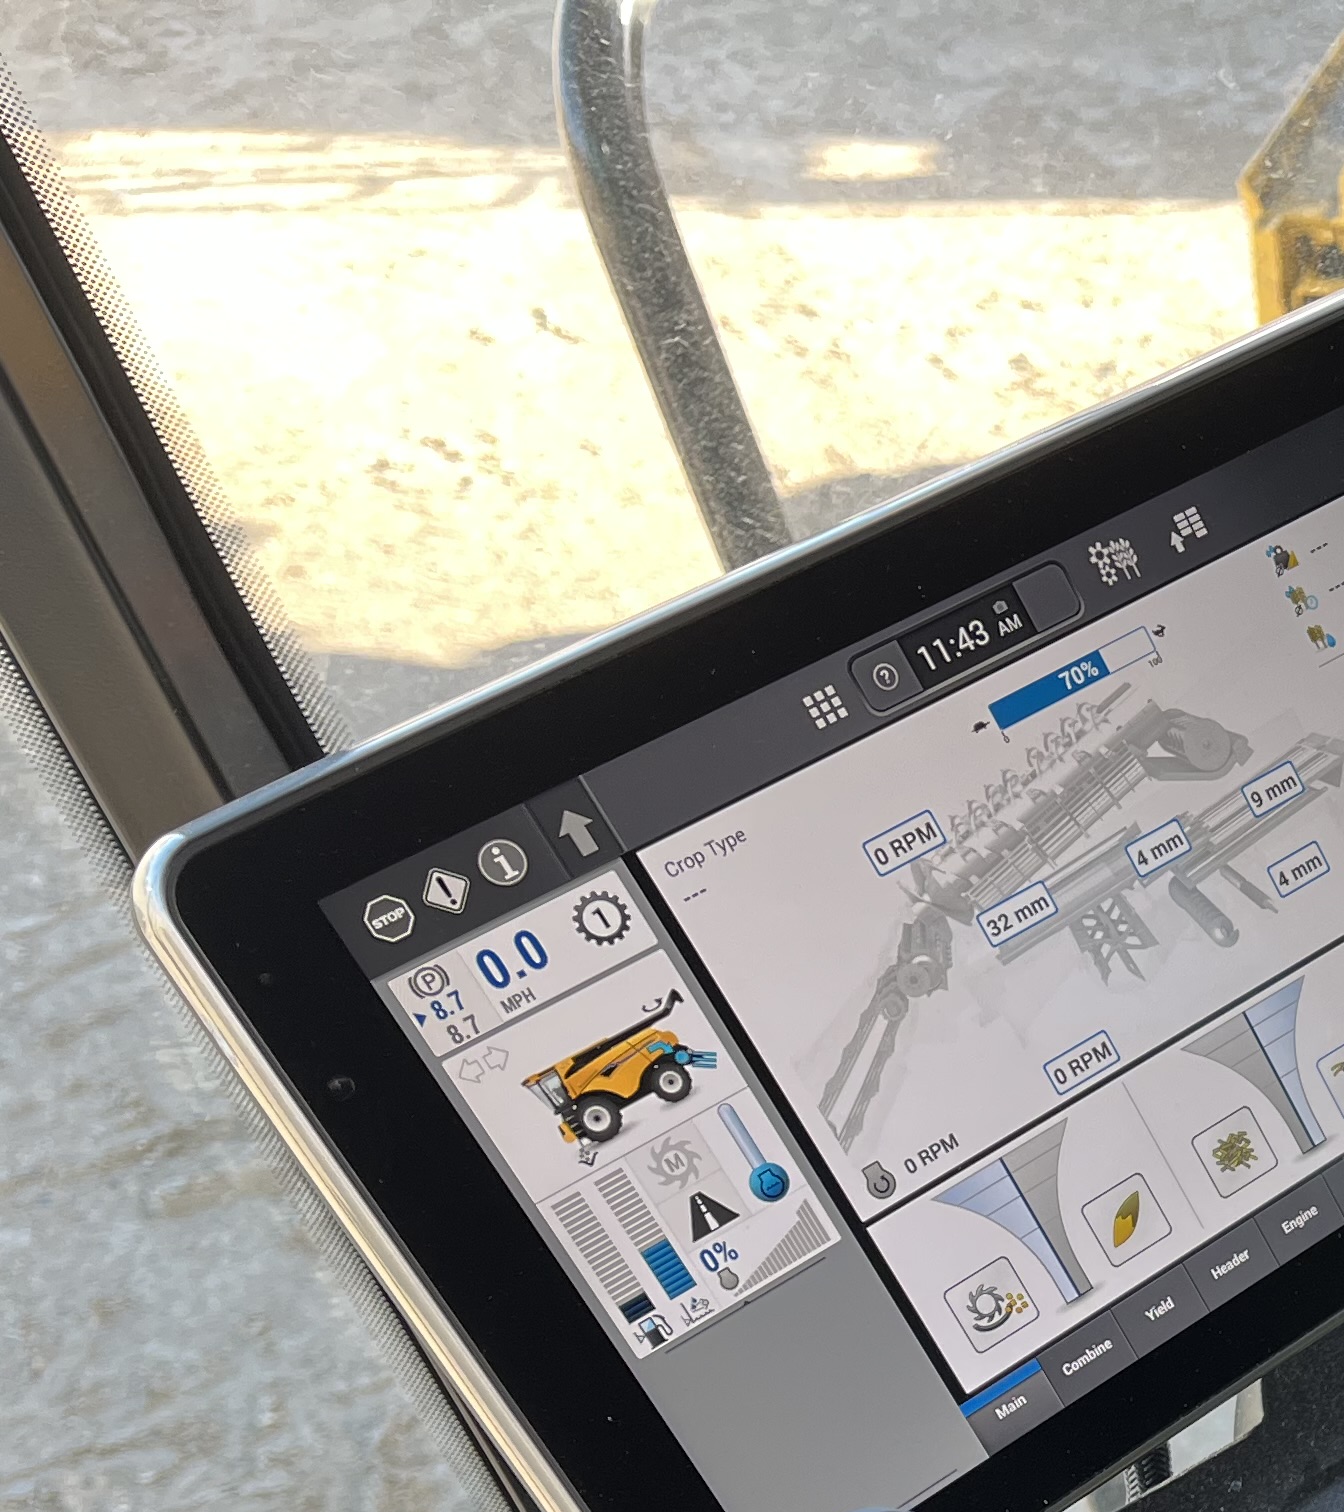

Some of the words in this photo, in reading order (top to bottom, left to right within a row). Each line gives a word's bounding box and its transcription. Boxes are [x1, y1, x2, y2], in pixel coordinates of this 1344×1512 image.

[916, 619, 990, 671] 11:43
[997, 613, 1024, 637] AM
[1057, 660, 1099, 691] 70%
[1249, 790, 1264, 808] 9
[1264, 774, 1298, 801] mm
[664, 849, 706, 878] Crop
[703, 829, 748, 858] Type
[873, 846, 890, 866] 0
[888, 821, 939, 858] RPM
[1136, 849, 1149, 867] 4
[1149, 832, 1185, 861] mm
[1278, 870, 1290, 887] 4
[1290, 854, 1323, 881] mm
[371, 906, 405, 930] STOP
[592, 906, 611, 929] 1
[986, 912, 1014, 938] 32
[1013, 895, 1050, 924] mm
[476, 929, 548, 989] 0.0
[430, 989, 464, 1020] 8.7
[500, 986, 537, 1014] MPH
[446, 1013, 480, 1044] 8.7
[1053, 1068, 1068, 1085] 0
[1067, 1040, 1113, 1078] RPM
[903, 1157, 918, 1174] 0
[917, 1132, 960, 1167] RPM
[1281, 1206, 1319, 1235] Engine
[700, 1240, 739, 1272] 0%
[1210, 1249, 1250, 1281] Header
[1144, 1296, 1175, 1321] Yield
[1062, 1339, 1114, 1376] Combine
[994, 1395, 1028, 1420] Main
